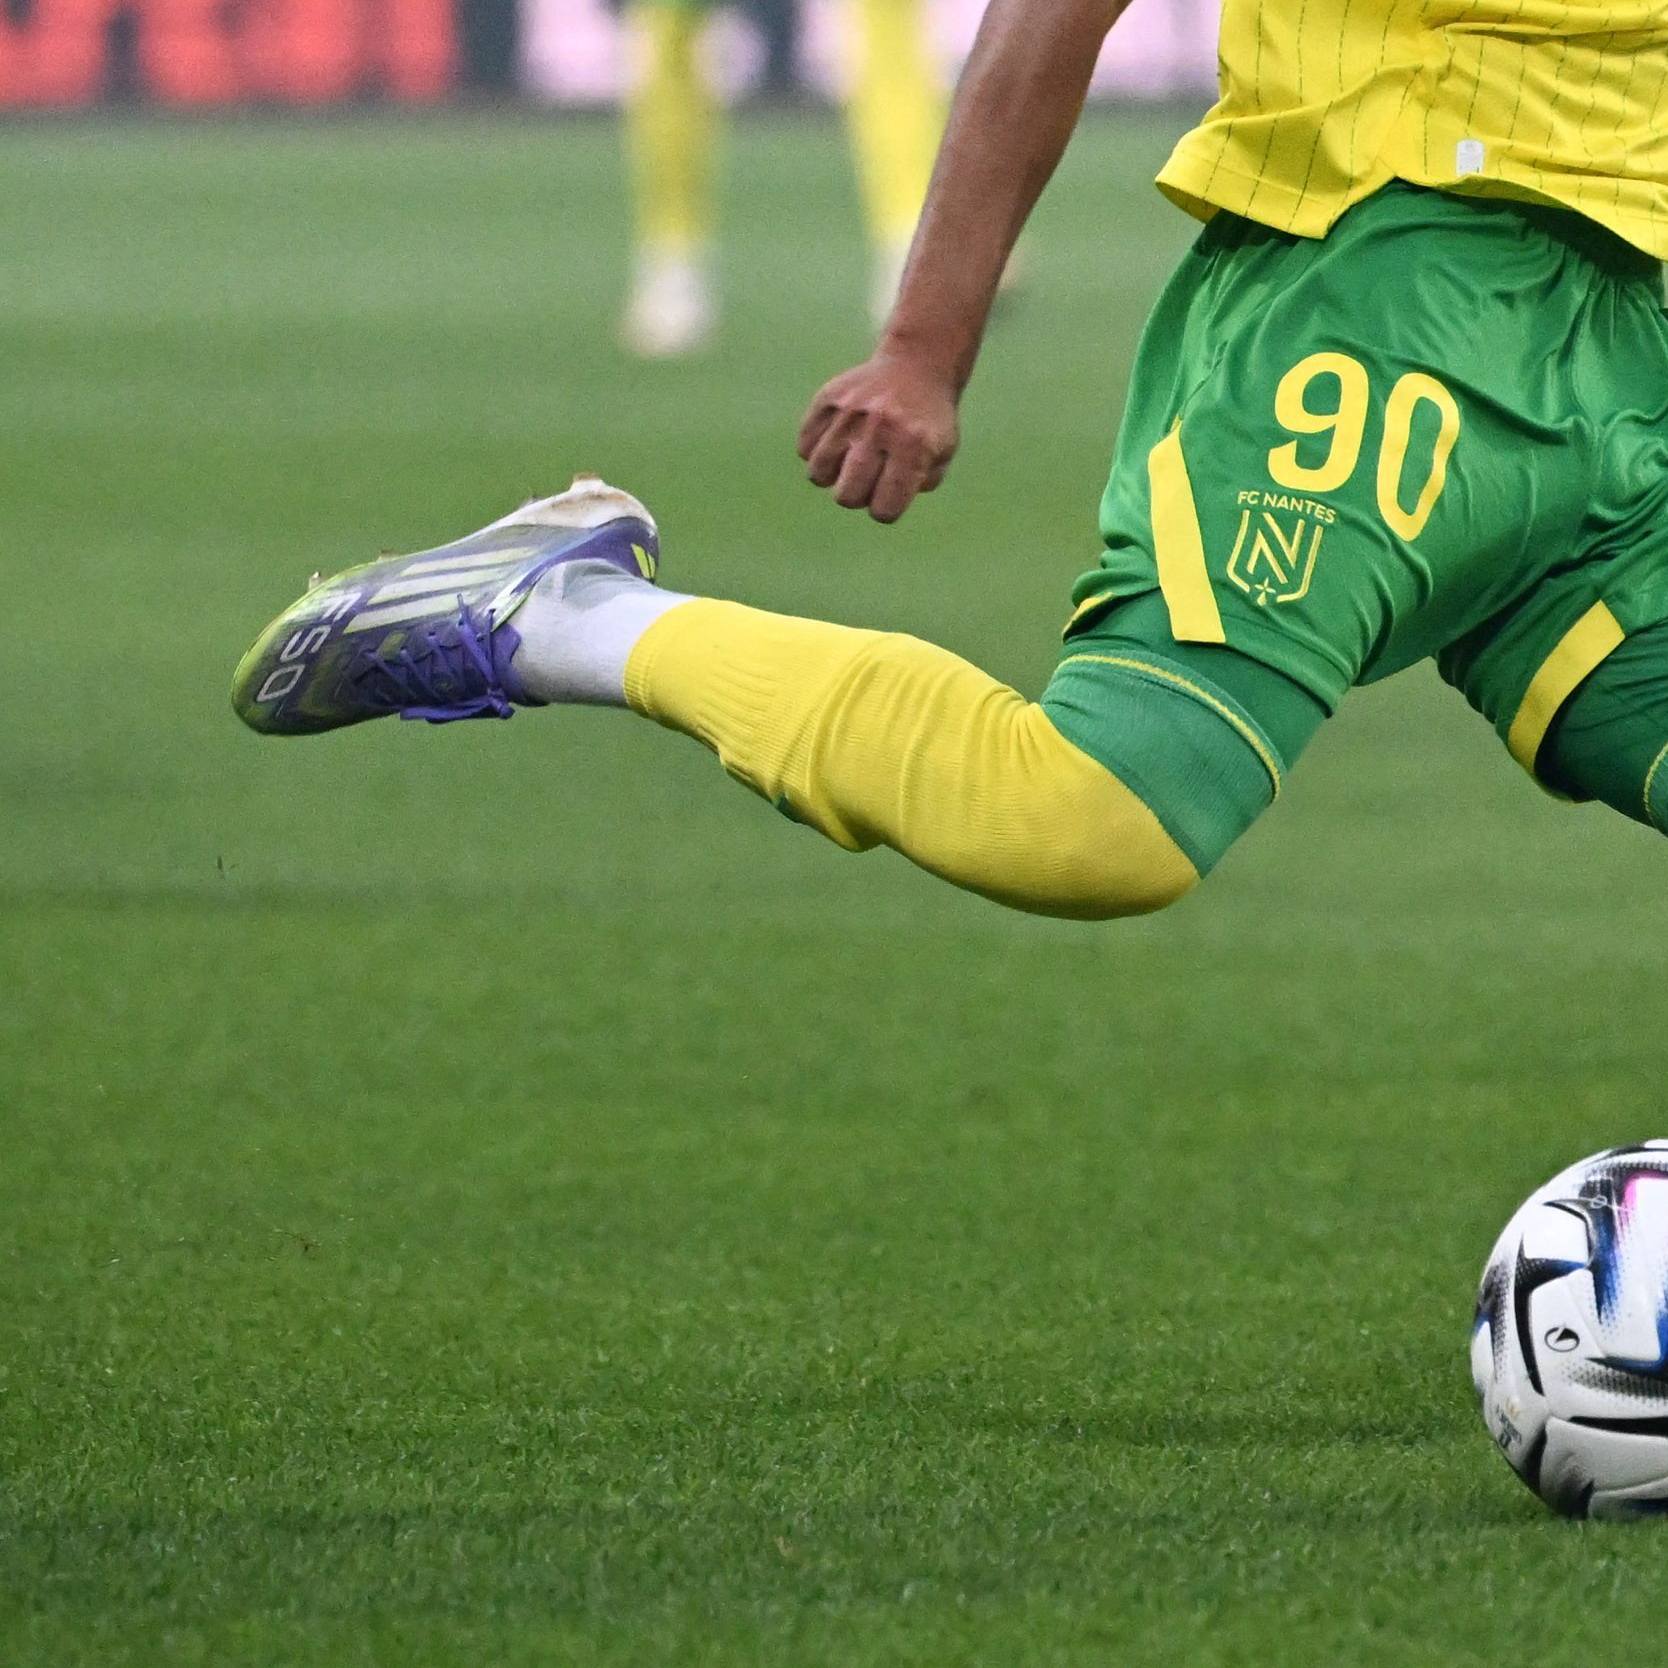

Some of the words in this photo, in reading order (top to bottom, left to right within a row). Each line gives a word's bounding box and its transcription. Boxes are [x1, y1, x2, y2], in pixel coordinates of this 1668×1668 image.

[1268, 352, 1460, 542] 90
[1237, 491, 1260, 505] FC
[1263, 492, 1337, 524] NANTES
